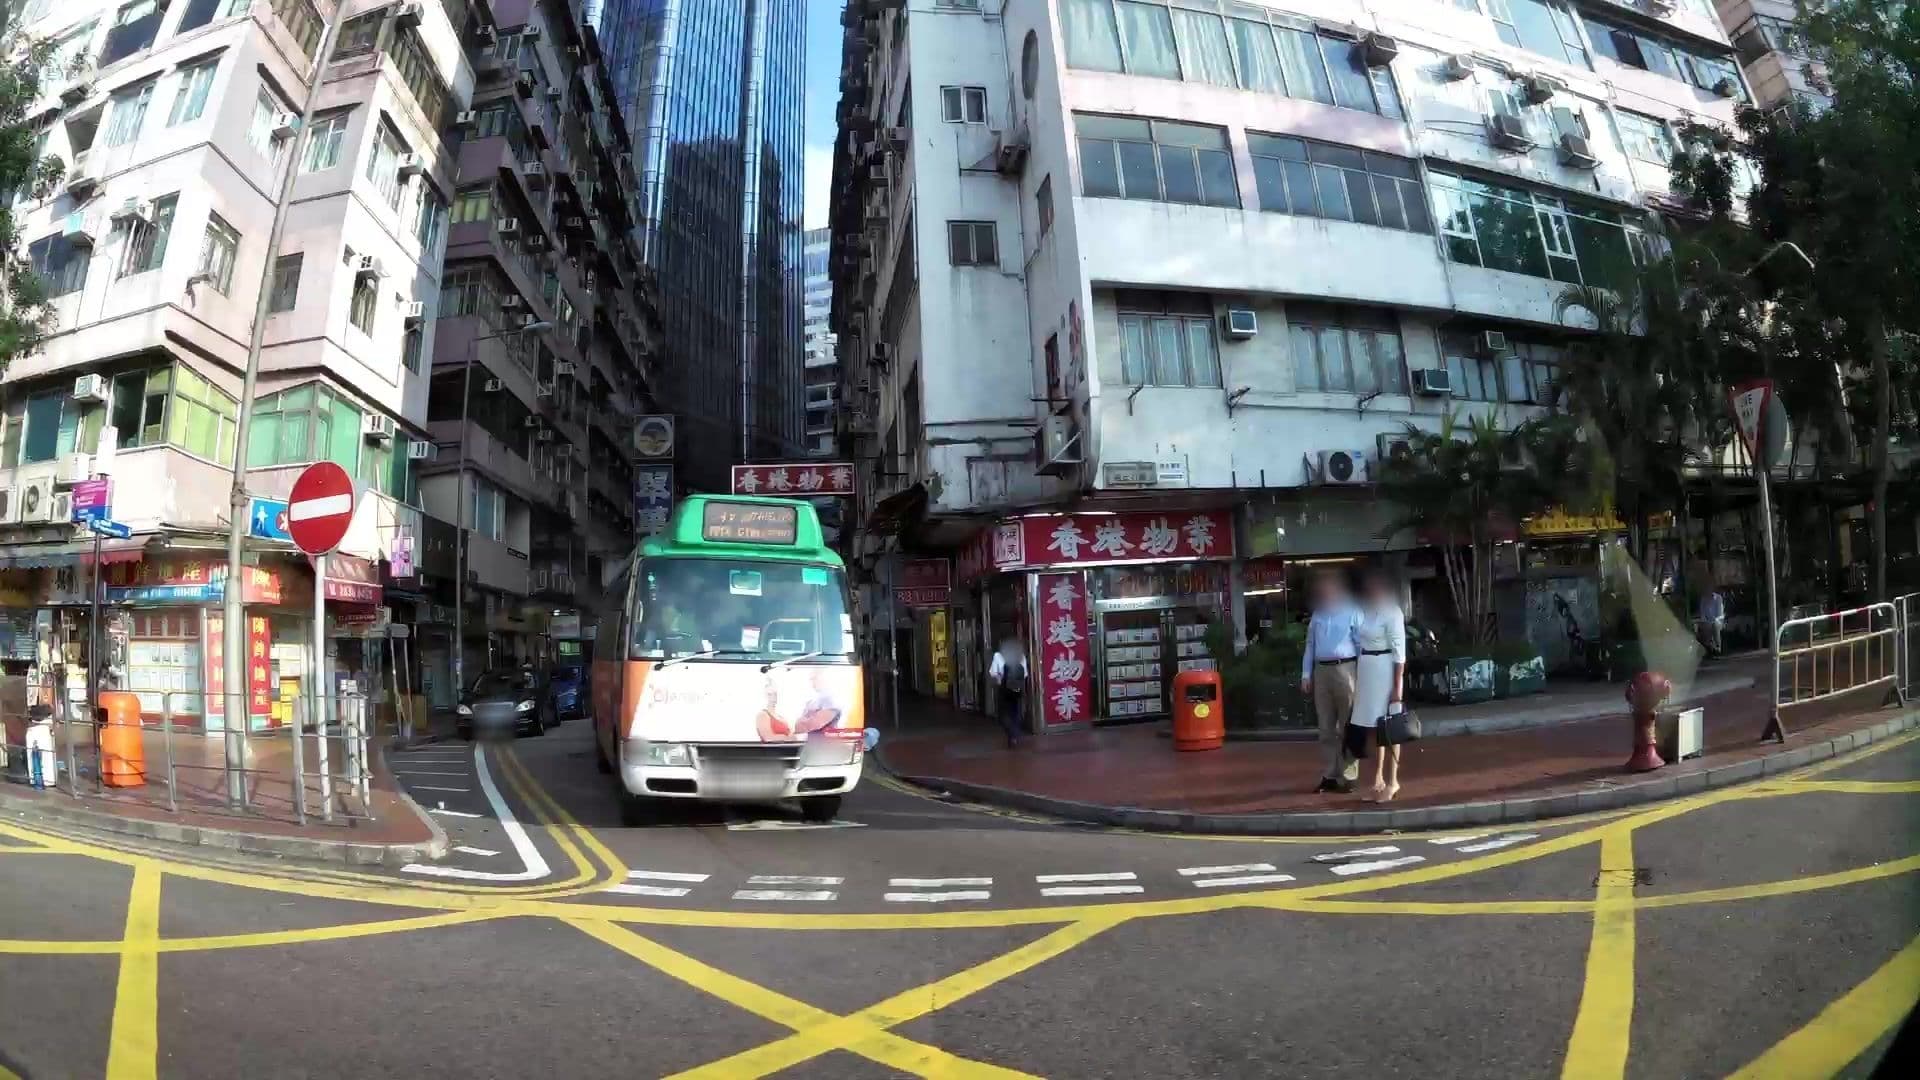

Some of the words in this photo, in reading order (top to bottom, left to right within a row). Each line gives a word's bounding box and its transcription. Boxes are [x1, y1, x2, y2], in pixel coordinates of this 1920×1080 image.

[737, 467, 852, 493] 香港物業
[1047, 515, 1216, 560] 香港物業
[1046, 577, 1084, 721] 香港物業
